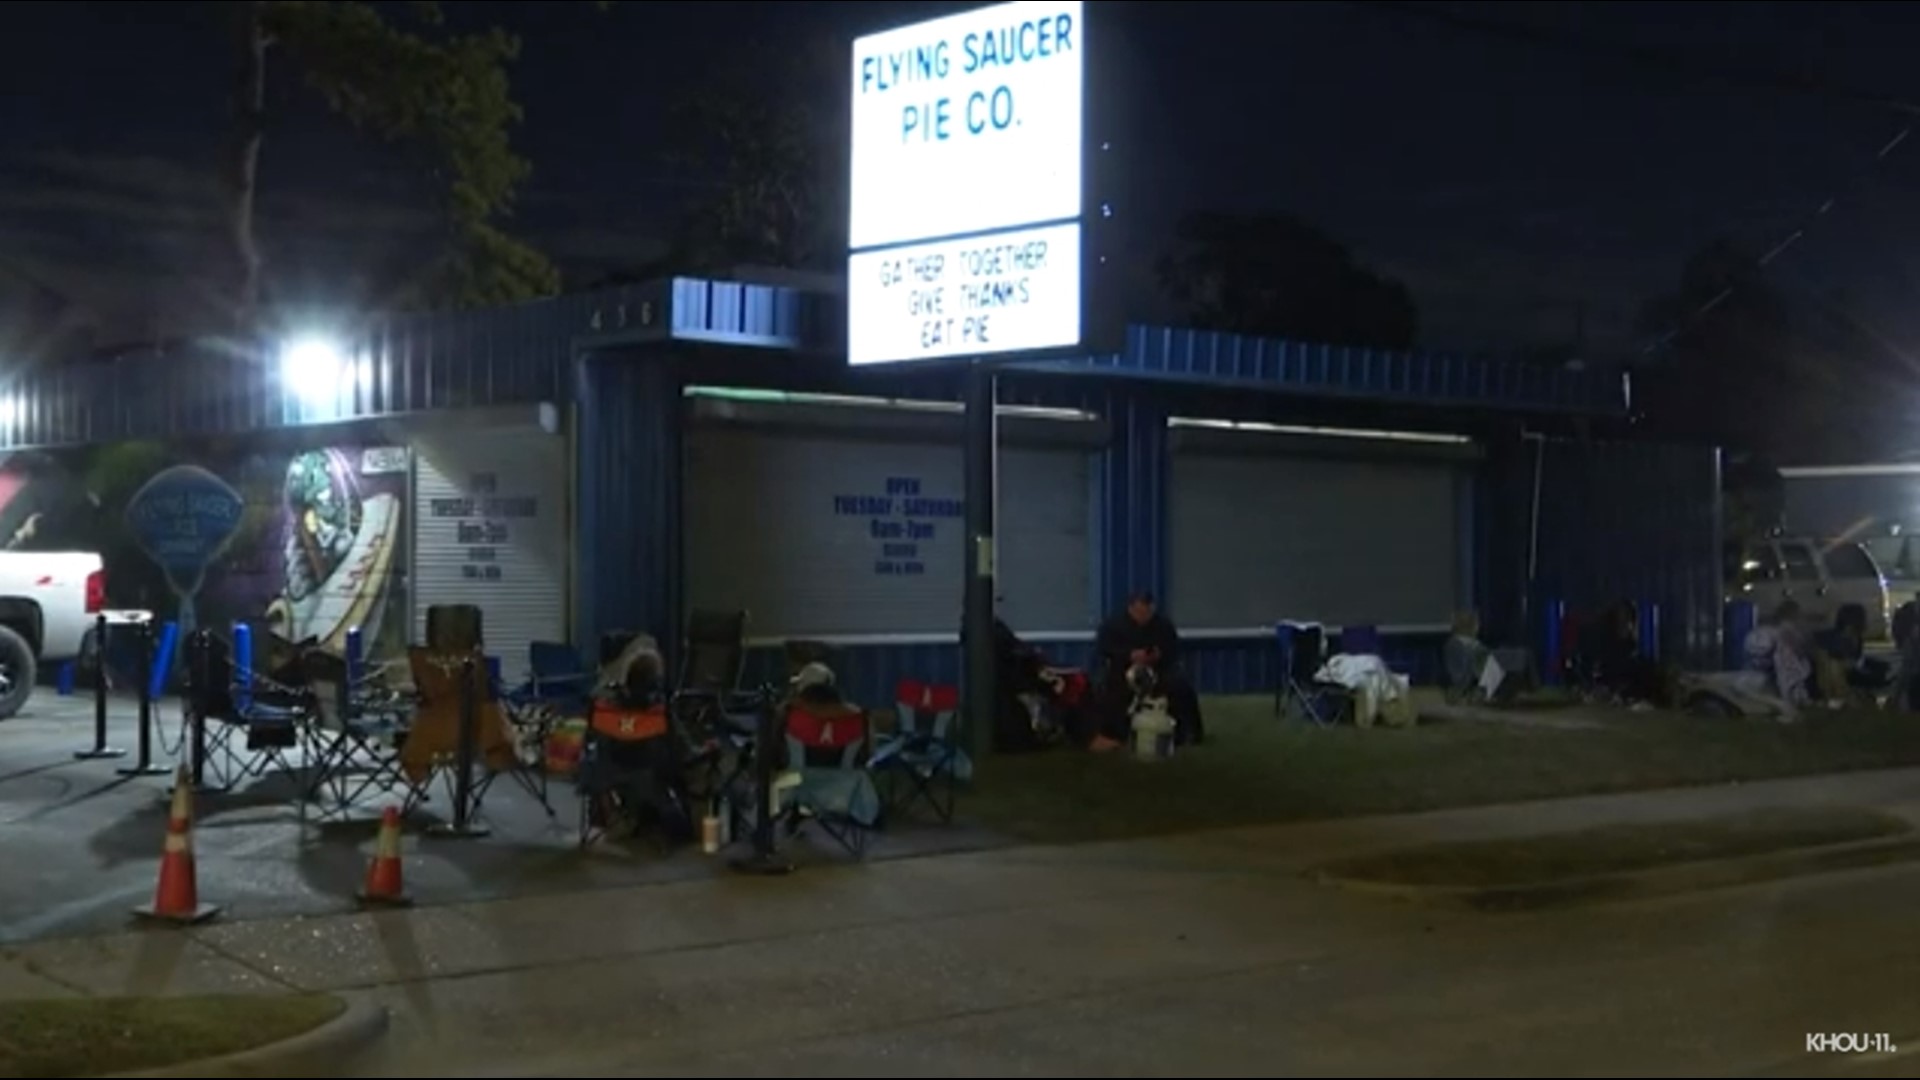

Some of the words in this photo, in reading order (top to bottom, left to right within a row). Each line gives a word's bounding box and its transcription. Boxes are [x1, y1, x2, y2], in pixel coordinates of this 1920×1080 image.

[863, 40, 951, 94] FLYING
[963, 13, 1073, 74] SAUCER
[902, 98, 951, 144] PIE
[966, 86, 1022, 135] CO.
[879, 253, 945, 288] GATHER
[960, 240, 1048, 276] TOGETHER
[908, 286, 944, 316] GIVE
[960, 277, 1030, 310] THANKS
[921, 318, 954, 349] EAT
[962, 315, 990, 343] PIE
[834, 496, 893, 515] TUESDAY
[903, 497, 964, 517] SATURDA
